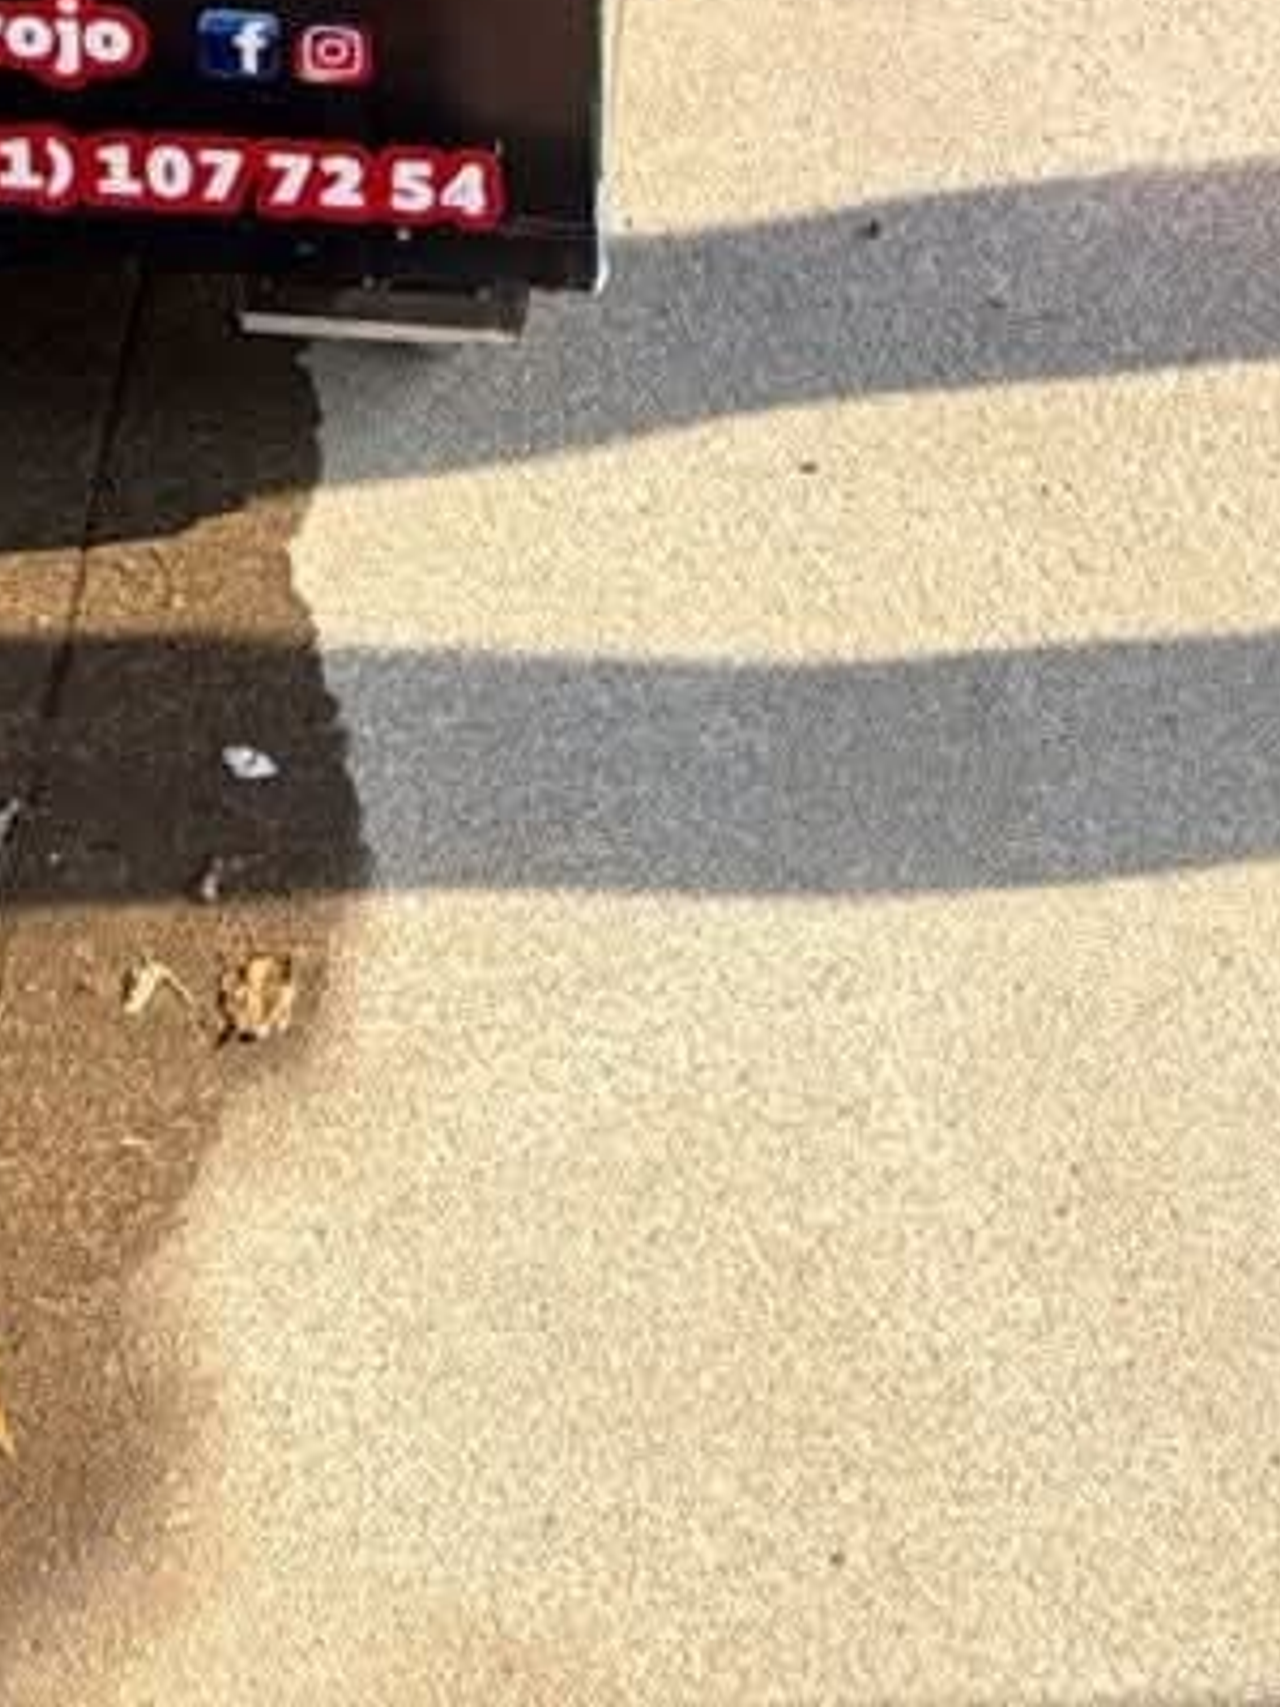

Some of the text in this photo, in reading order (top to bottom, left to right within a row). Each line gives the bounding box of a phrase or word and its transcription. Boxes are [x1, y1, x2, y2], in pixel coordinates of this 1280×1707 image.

[95, 143, 244, 201] 107
[266, 151, 365, 207] 72
[389, 160, 487, 215] 54
